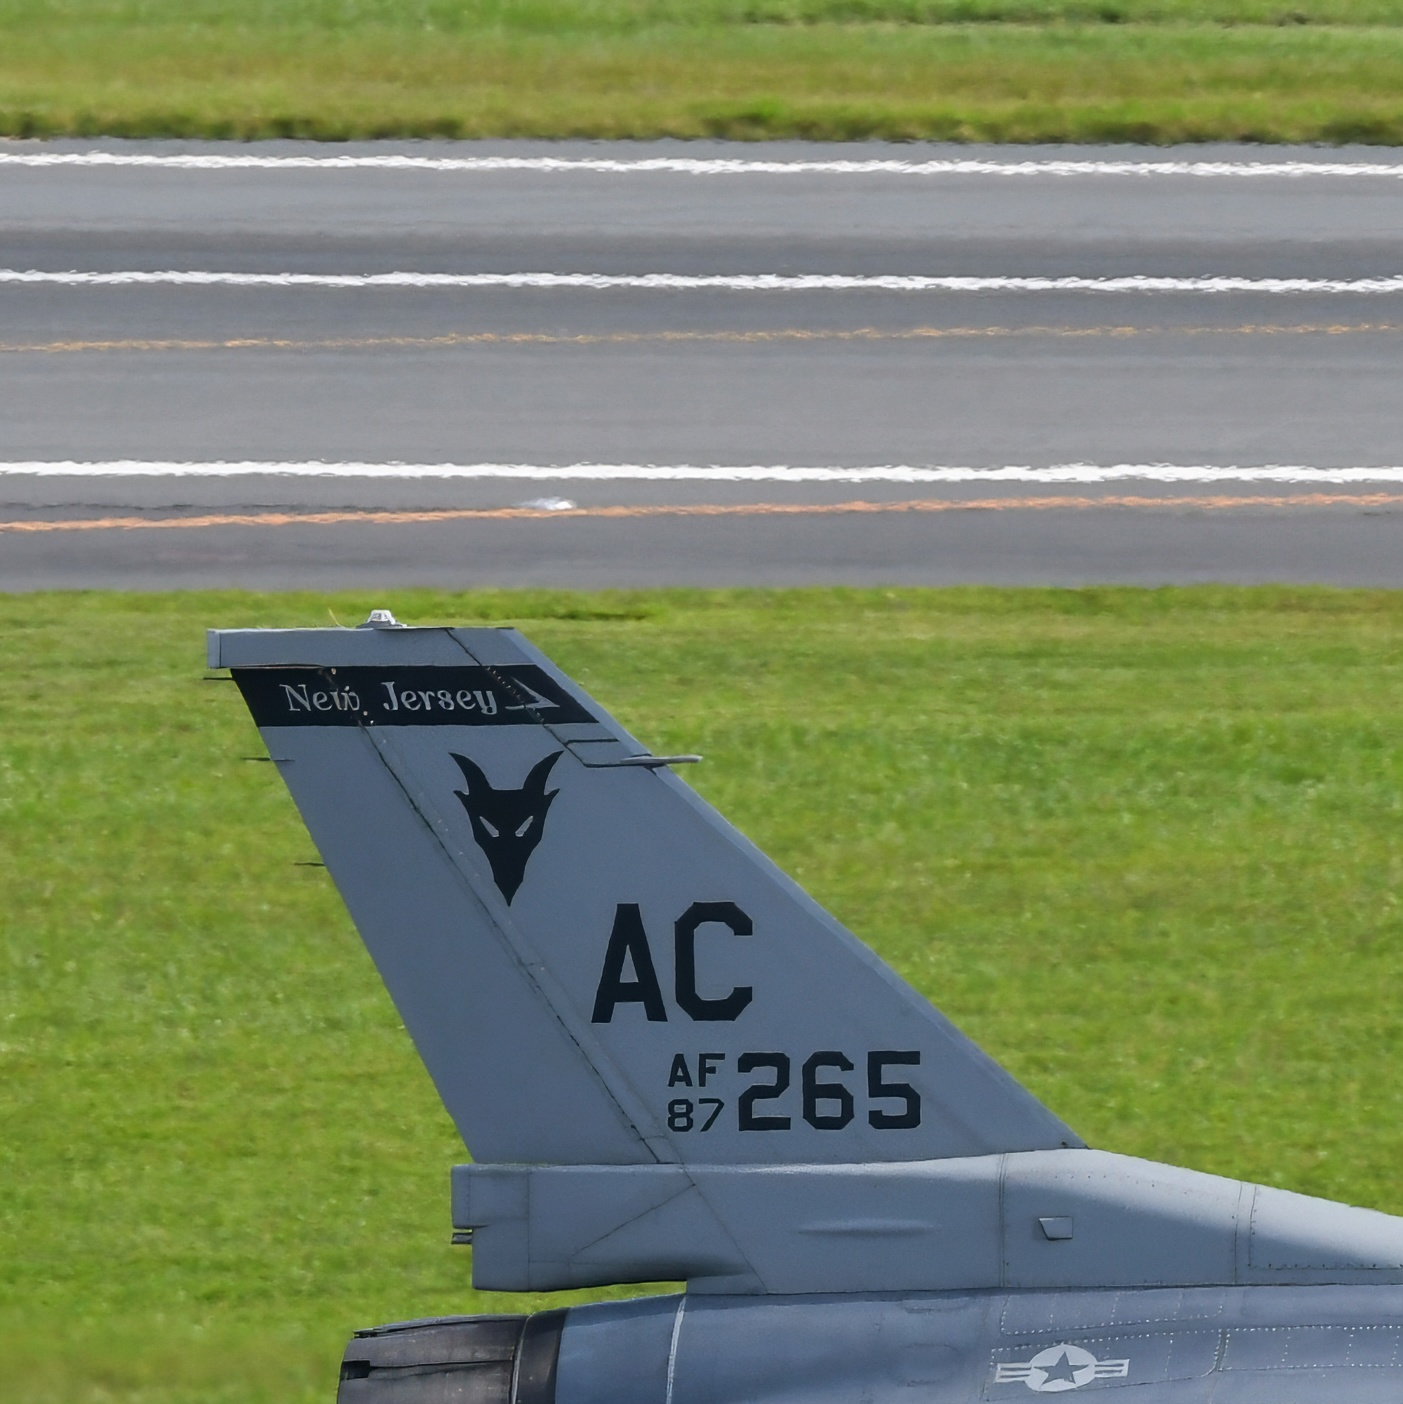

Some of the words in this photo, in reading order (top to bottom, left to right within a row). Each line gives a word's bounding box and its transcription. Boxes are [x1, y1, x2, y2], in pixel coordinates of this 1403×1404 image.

[279, 684, 360, 711] New
[381, 681, 498, 715] Jersey
[591, 901, 753, 1023] AC
[667, 1098, 725, 1132] 87
[668, 1053, 726, 1087] AF
[737, 1051, 921, 1131] 265
